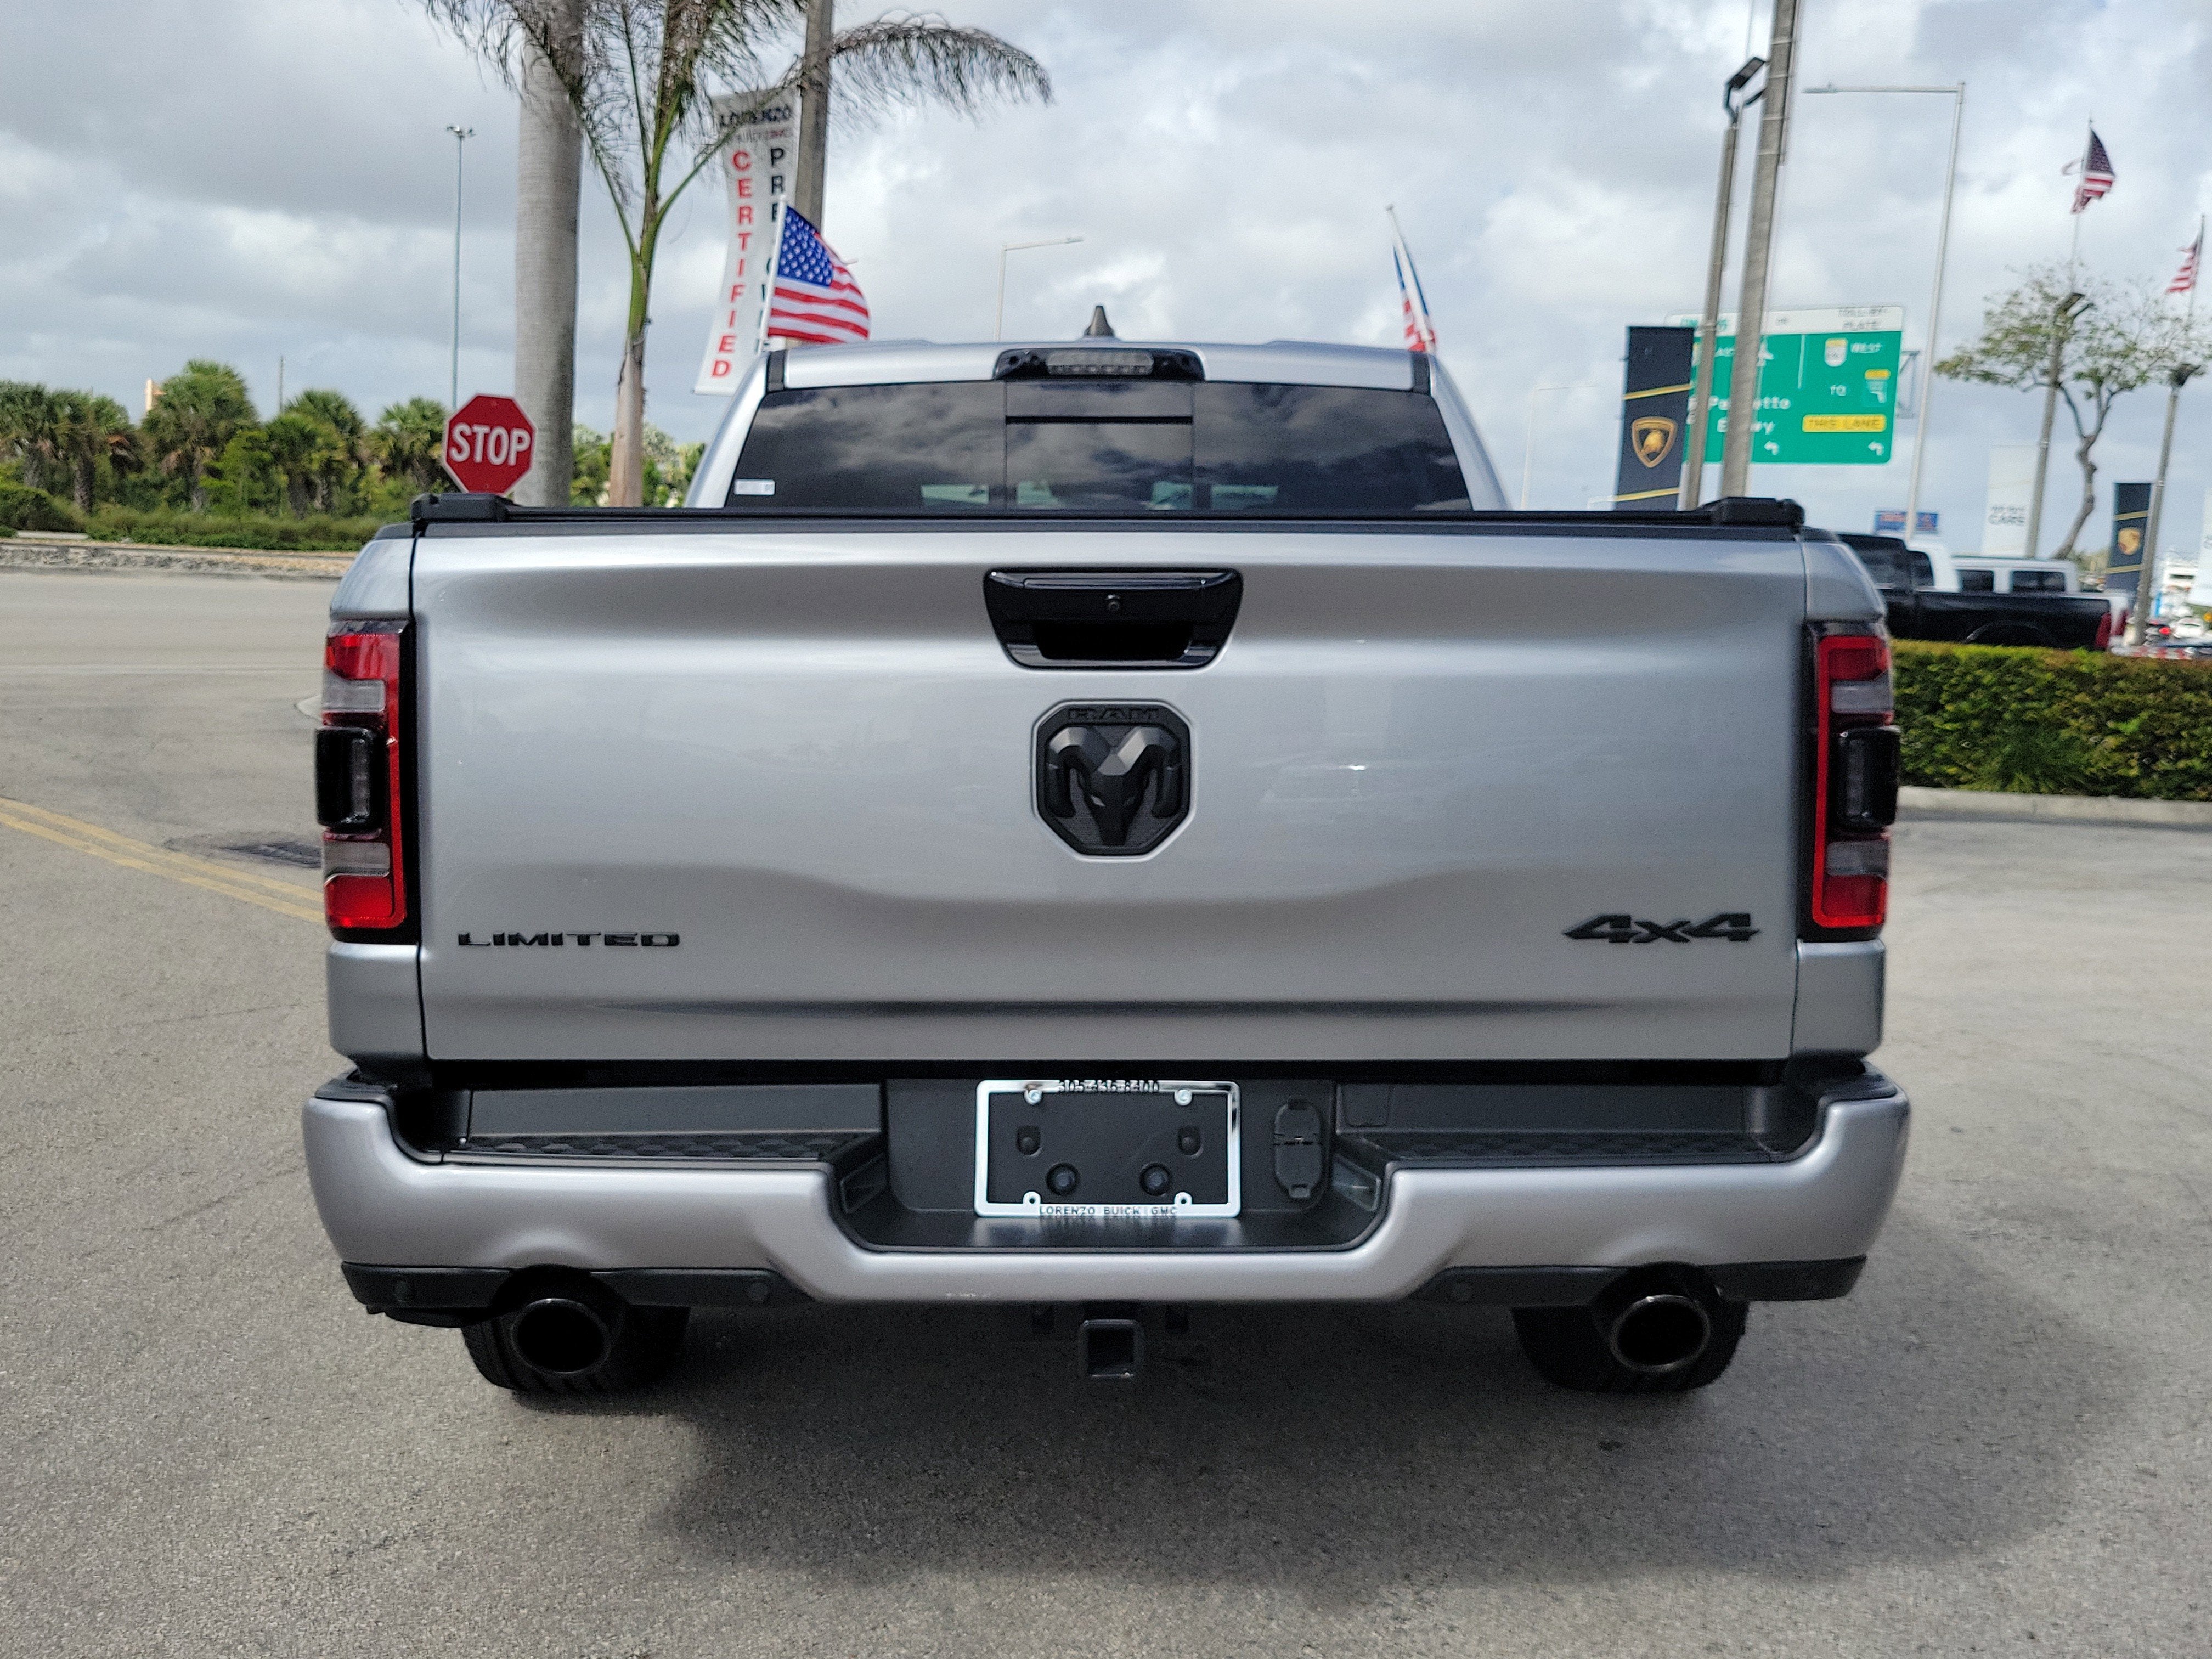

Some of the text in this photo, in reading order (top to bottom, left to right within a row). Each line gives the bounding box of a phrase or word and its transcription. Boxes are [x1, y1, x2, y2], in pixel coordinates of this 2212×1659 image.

[711, 150, 753, 378] CERTIFIED
[449, 422, 531, 466] STOP
[1068, 708, 1159, 720] RAM
[458, 932, 680, 946] LIMITED
[1562, 913, 1760, 943] 4x4
[1039, 1206, 1178, 1216] LORENZO BUICK GMC
